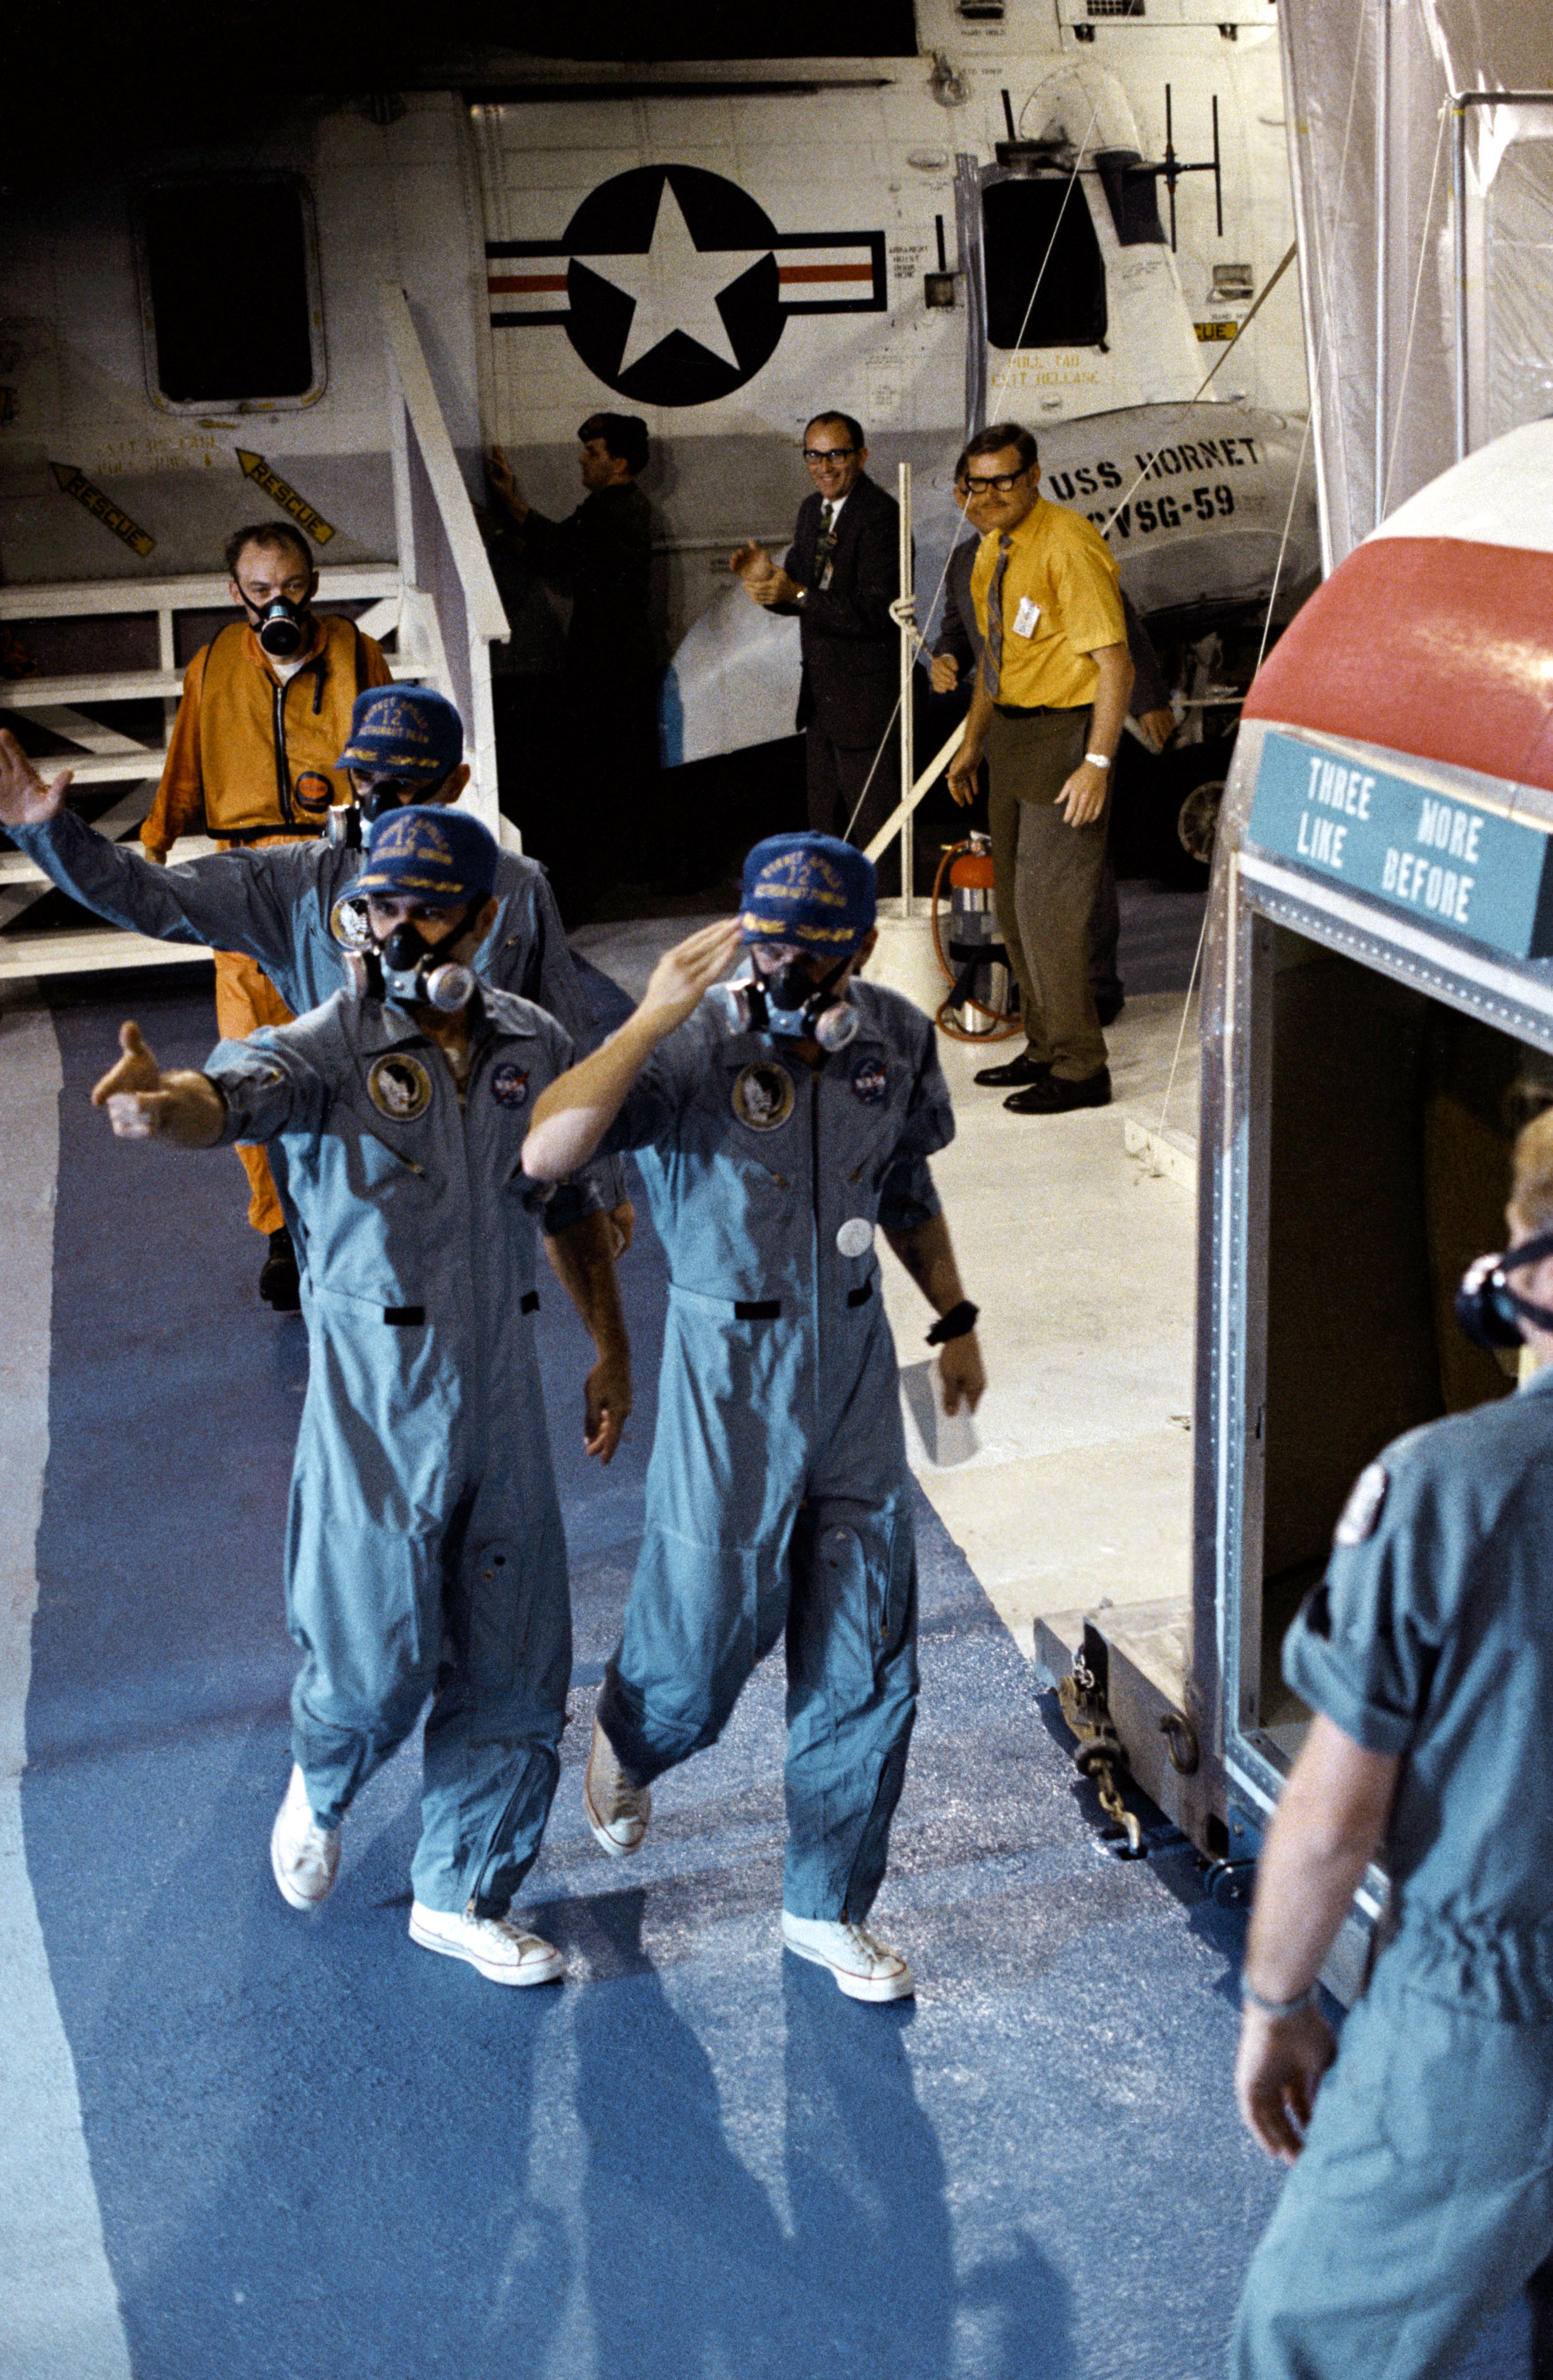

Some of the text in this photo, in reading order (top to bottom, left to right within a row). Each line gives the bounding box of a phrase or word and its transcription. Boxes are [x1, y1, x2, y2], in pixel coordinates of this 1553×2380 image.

[252, 462, 325, 536] RESCUE
[1048, 437, 1259, 501] USS HORNET
[66, 476, 143, 548] RESCUE
[382, 708, 402, 726] 12
[1307, 756, 1484, 865] THREE MORE
[1296, 810, 1475, 924] LIKE BEFORE
